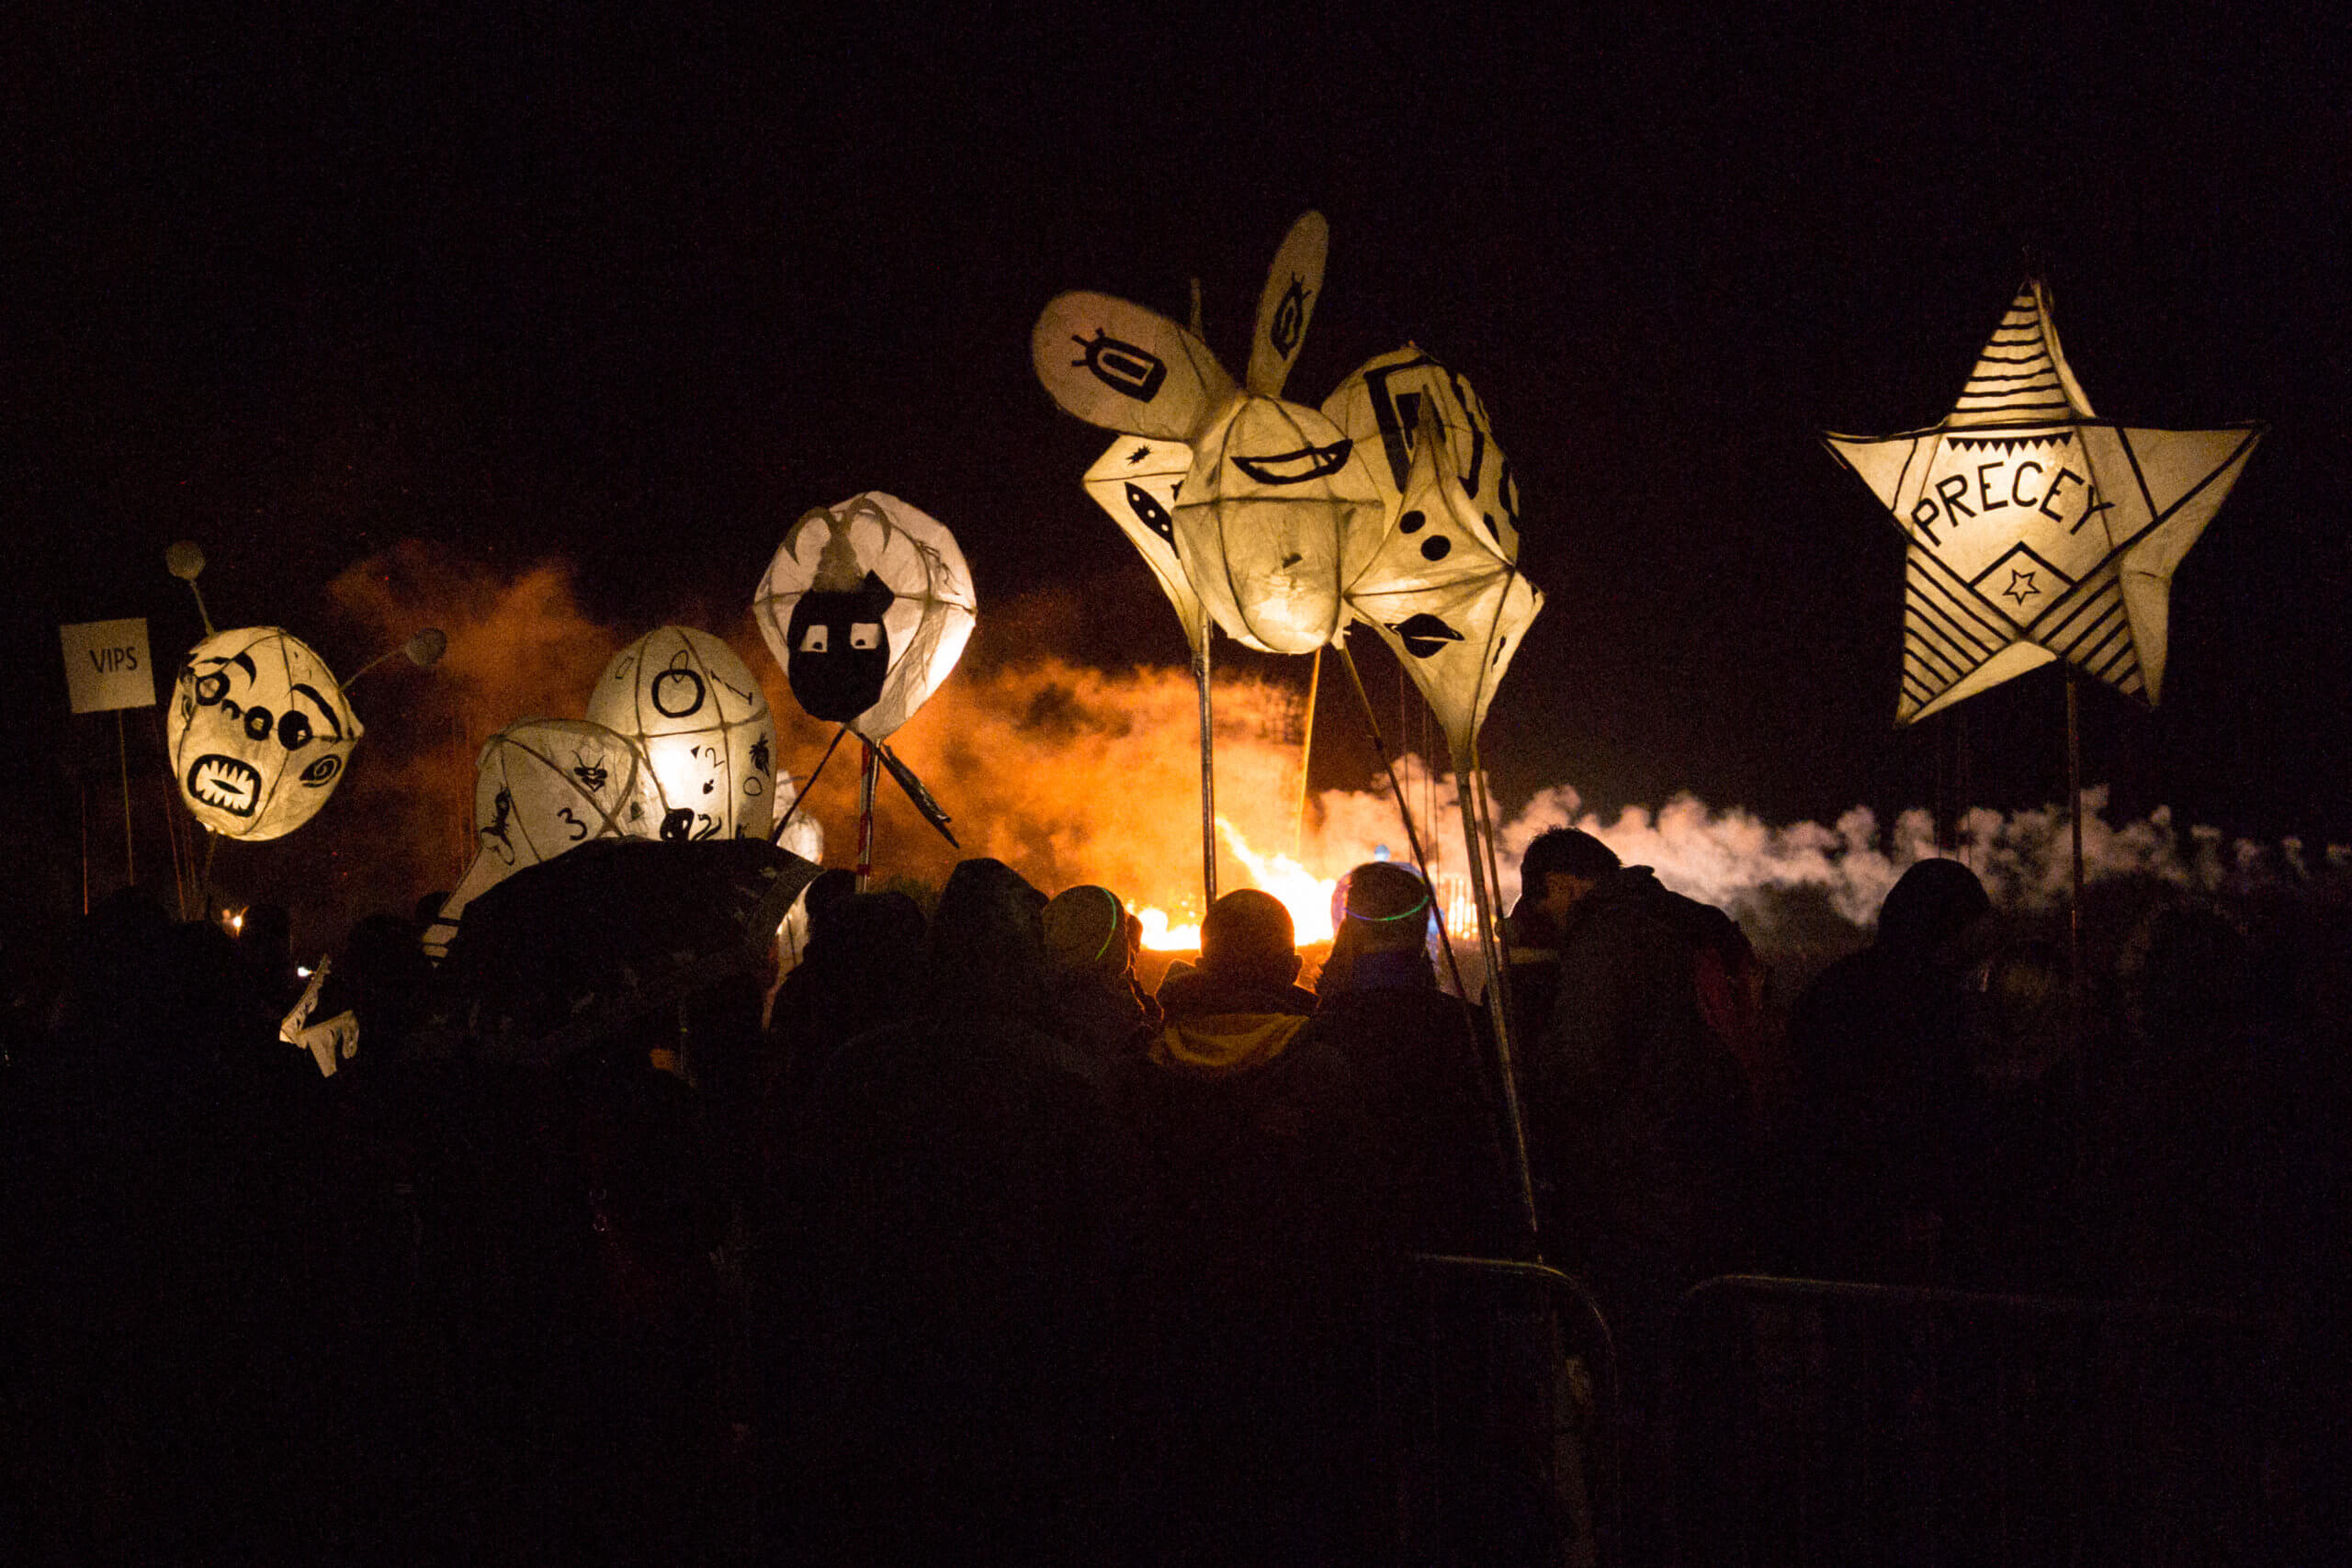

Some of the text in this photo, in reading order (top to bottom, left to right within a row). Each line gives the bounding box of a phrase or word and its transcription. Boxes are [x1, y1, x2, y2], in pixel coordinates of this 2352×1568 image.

[1911, 461, 2116, 547] PRECEY
[89, 646, 138, 673] VIPS
[557, 807, 588, 841] 3
